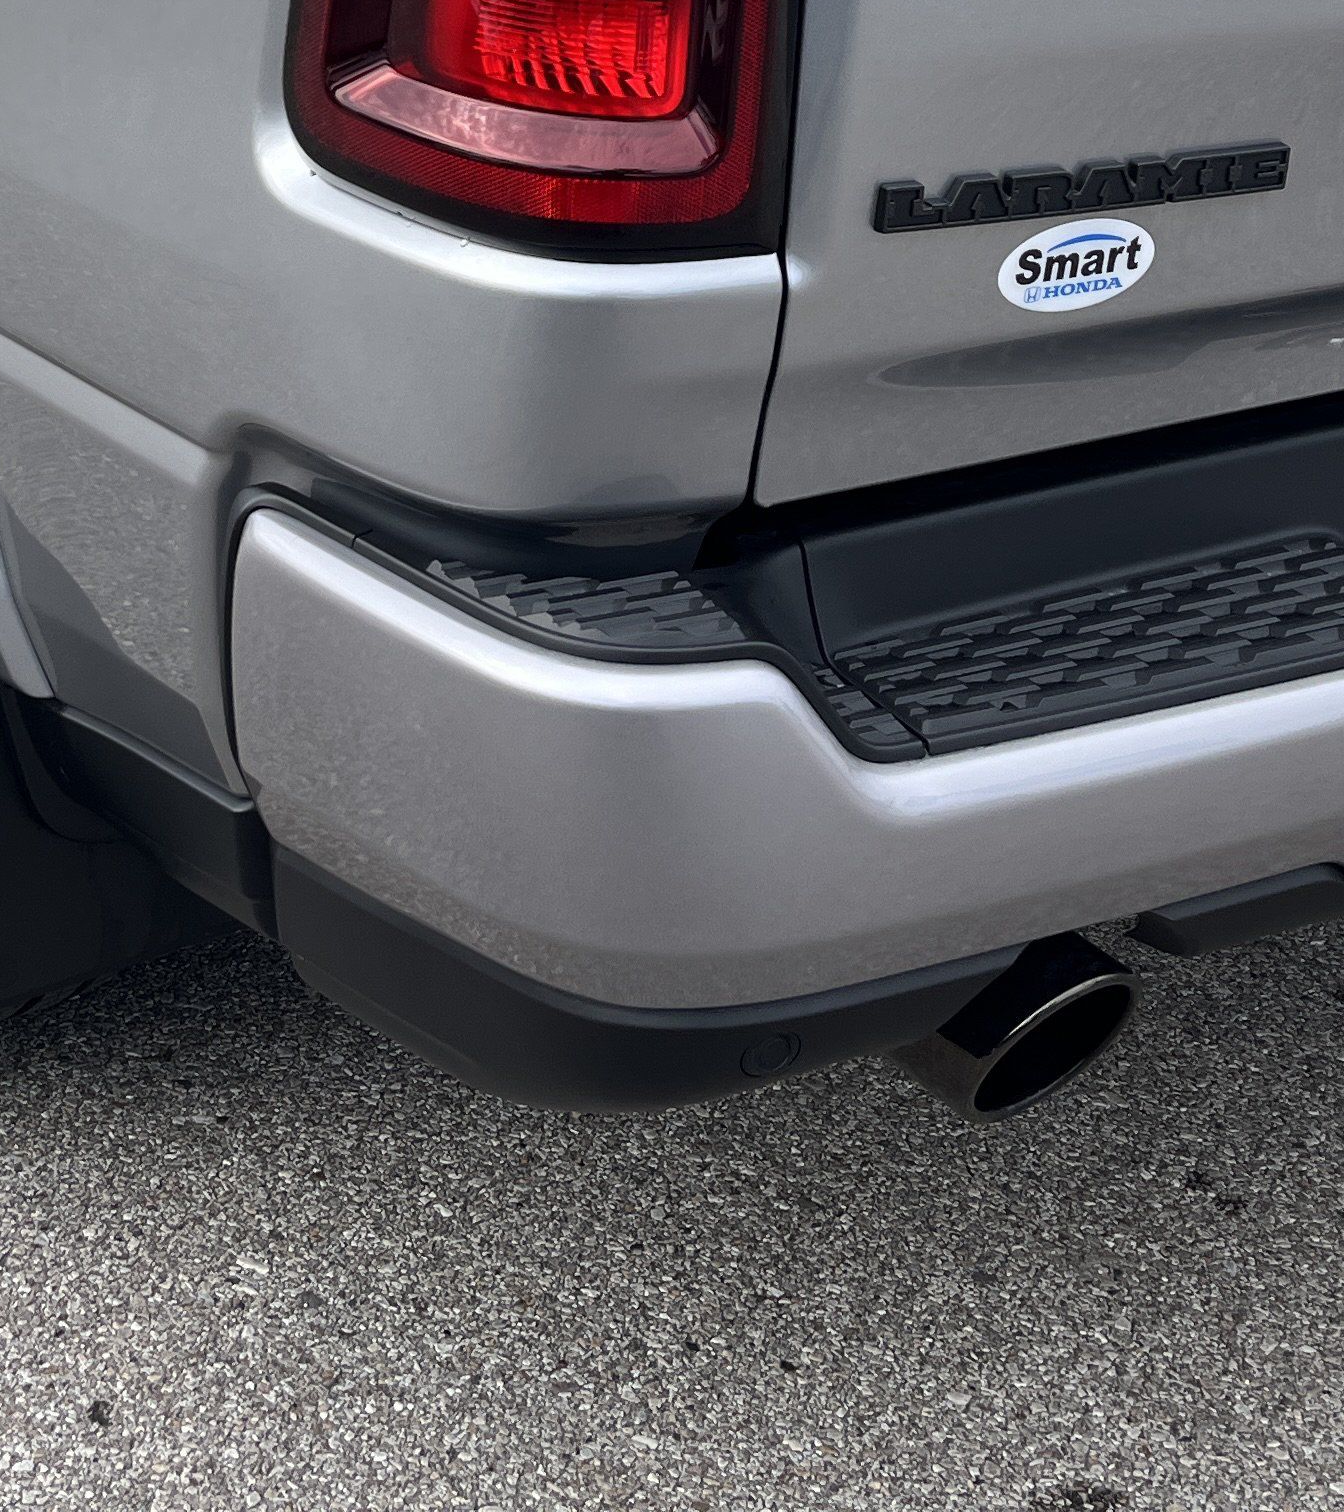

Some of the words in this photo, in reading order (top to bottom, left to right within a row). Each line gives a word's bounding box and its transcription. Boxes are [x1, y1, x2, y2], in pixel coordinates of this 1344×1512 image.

[873, 141, 1291, 233] LARAMIE
[1016, 236, 1143, 285] Smart
[1043, 276, 1123, 299] HONDA
